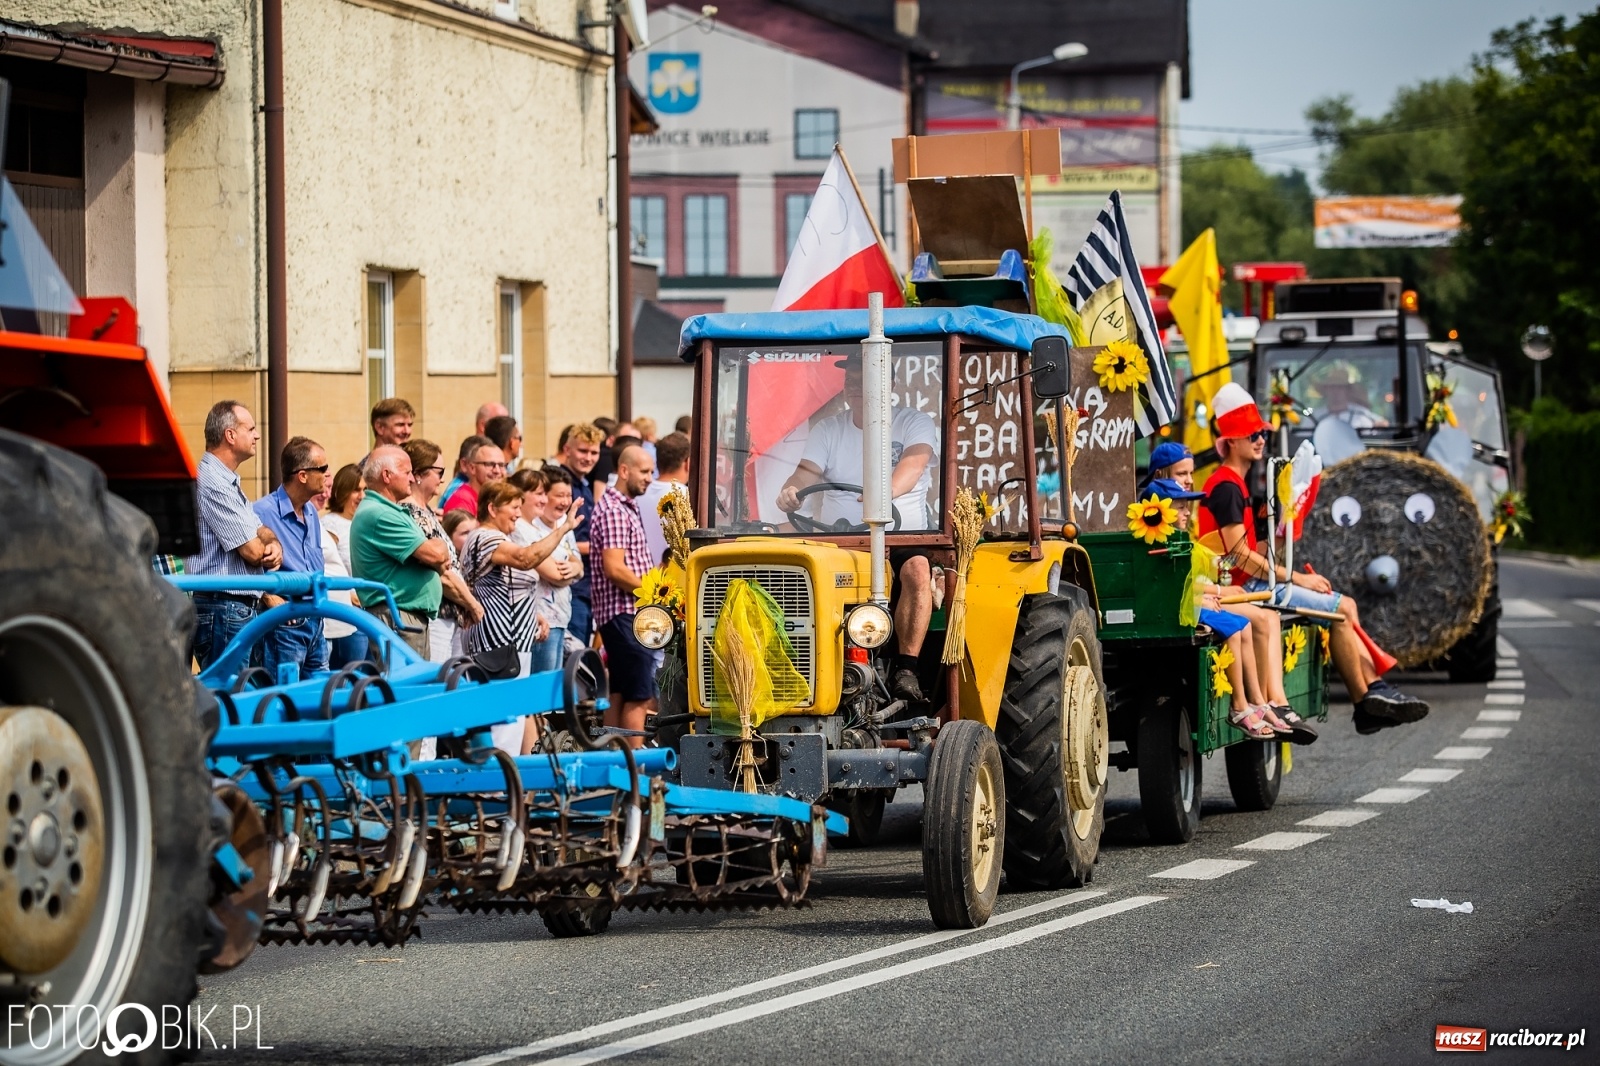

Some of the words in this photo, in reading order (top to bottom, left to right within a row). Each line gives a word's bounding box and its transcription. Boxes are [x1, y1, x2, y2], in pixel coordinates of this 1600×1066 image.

[632, 130, 690, 148] OWICE
[697, 128, 771, 147] WIELKIE
[763, 352, 821, 363] SUZUKI
